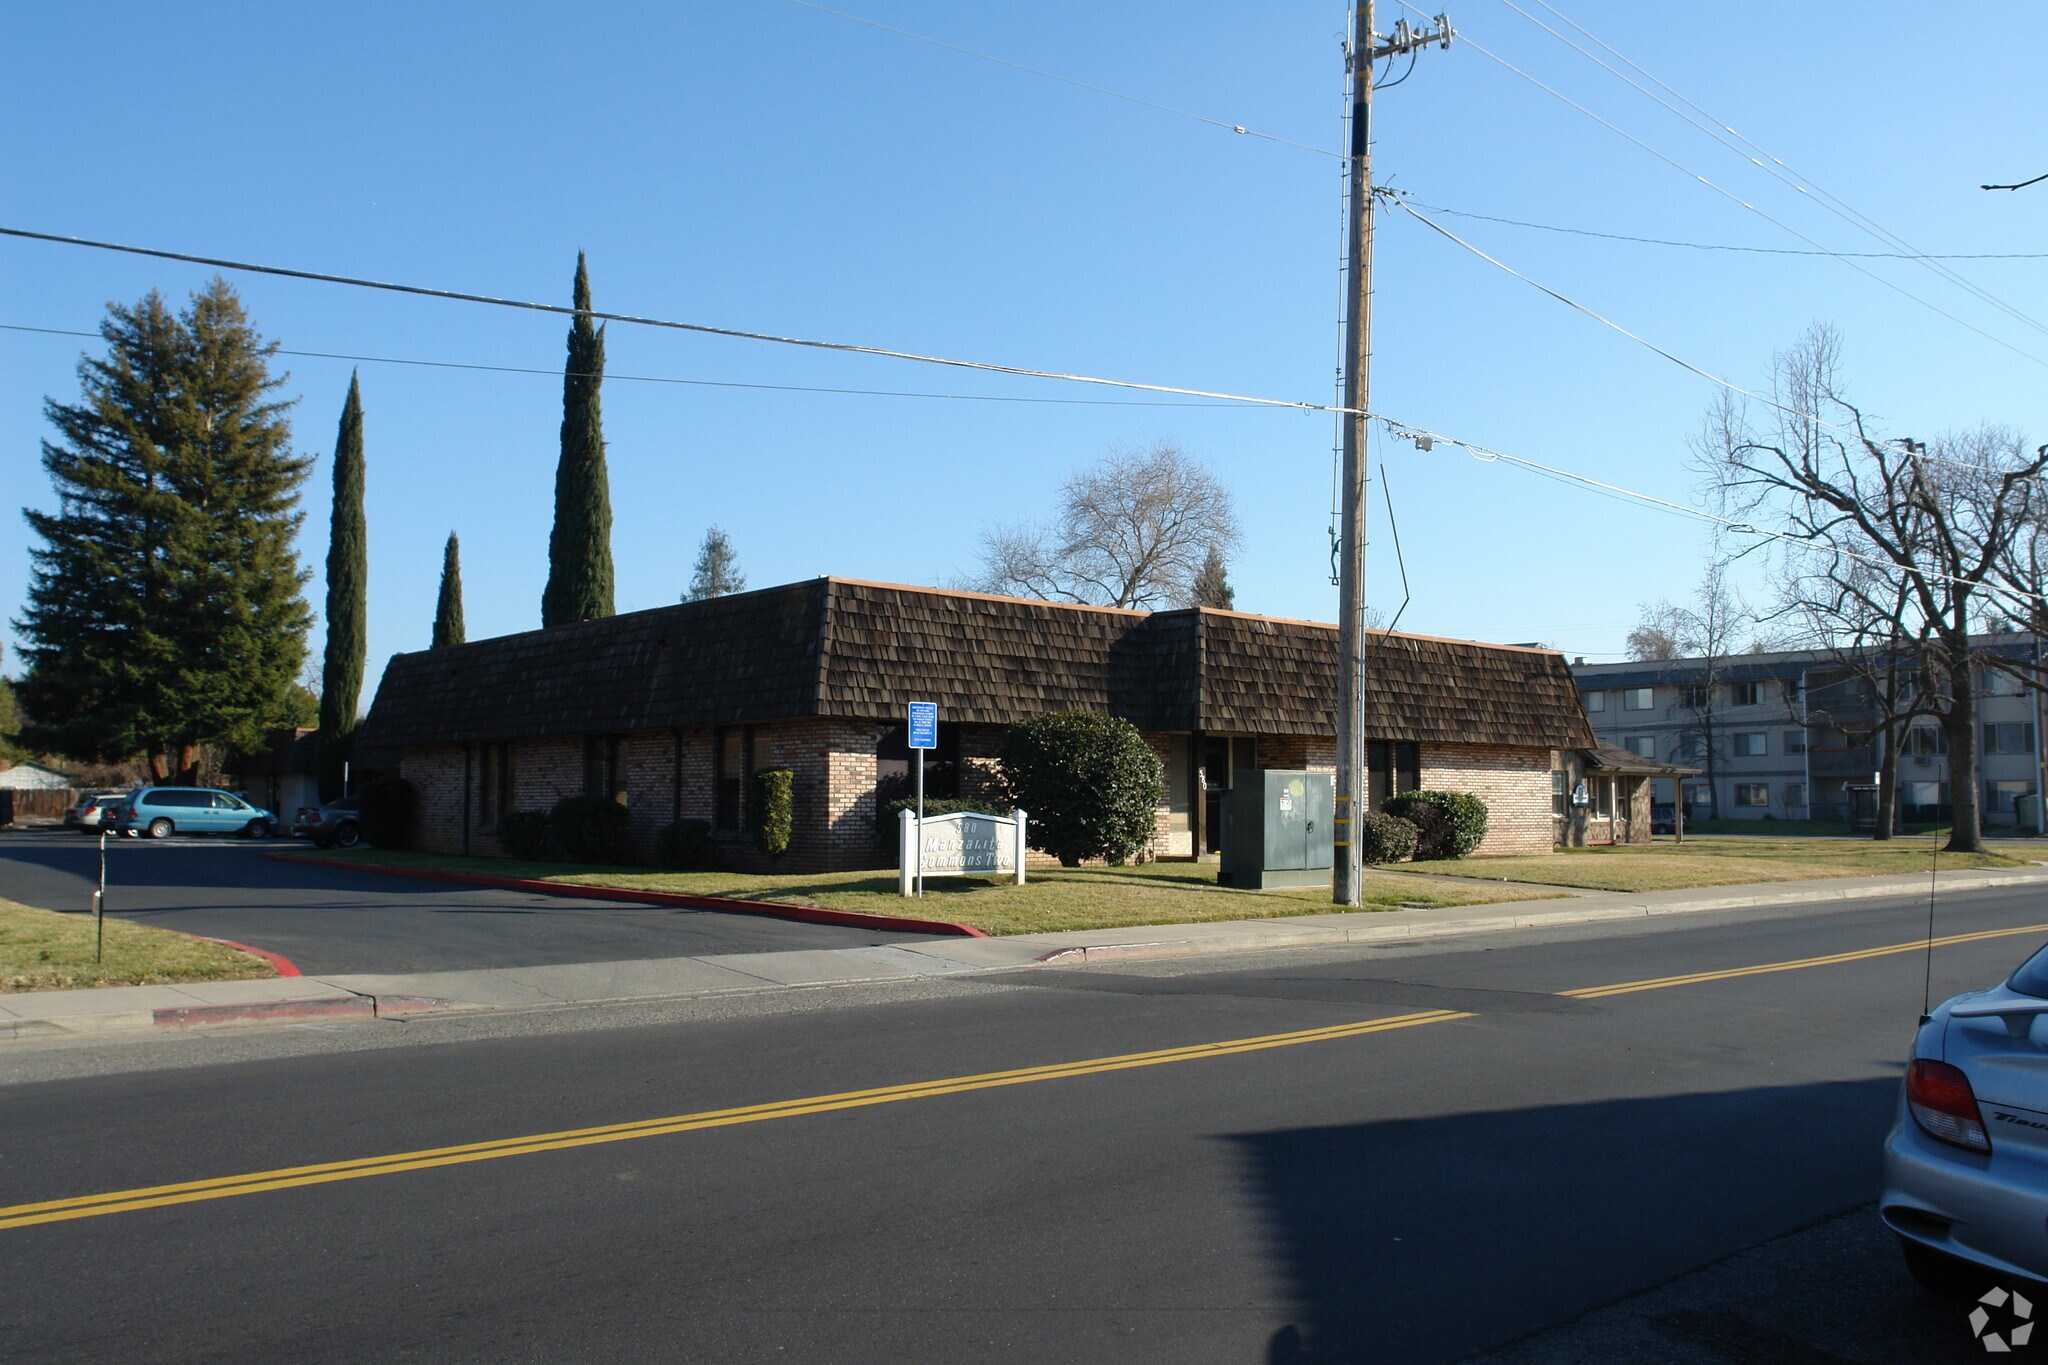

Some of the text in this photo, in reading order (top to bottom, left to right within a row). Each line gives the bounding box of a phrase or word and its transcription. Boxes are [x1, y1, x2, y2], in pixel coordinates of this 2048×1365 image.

[955, 822, 977, 834] 580
[925, 837, 1005, 853] Manzanita
[985, 852, 1010, 866] Two
